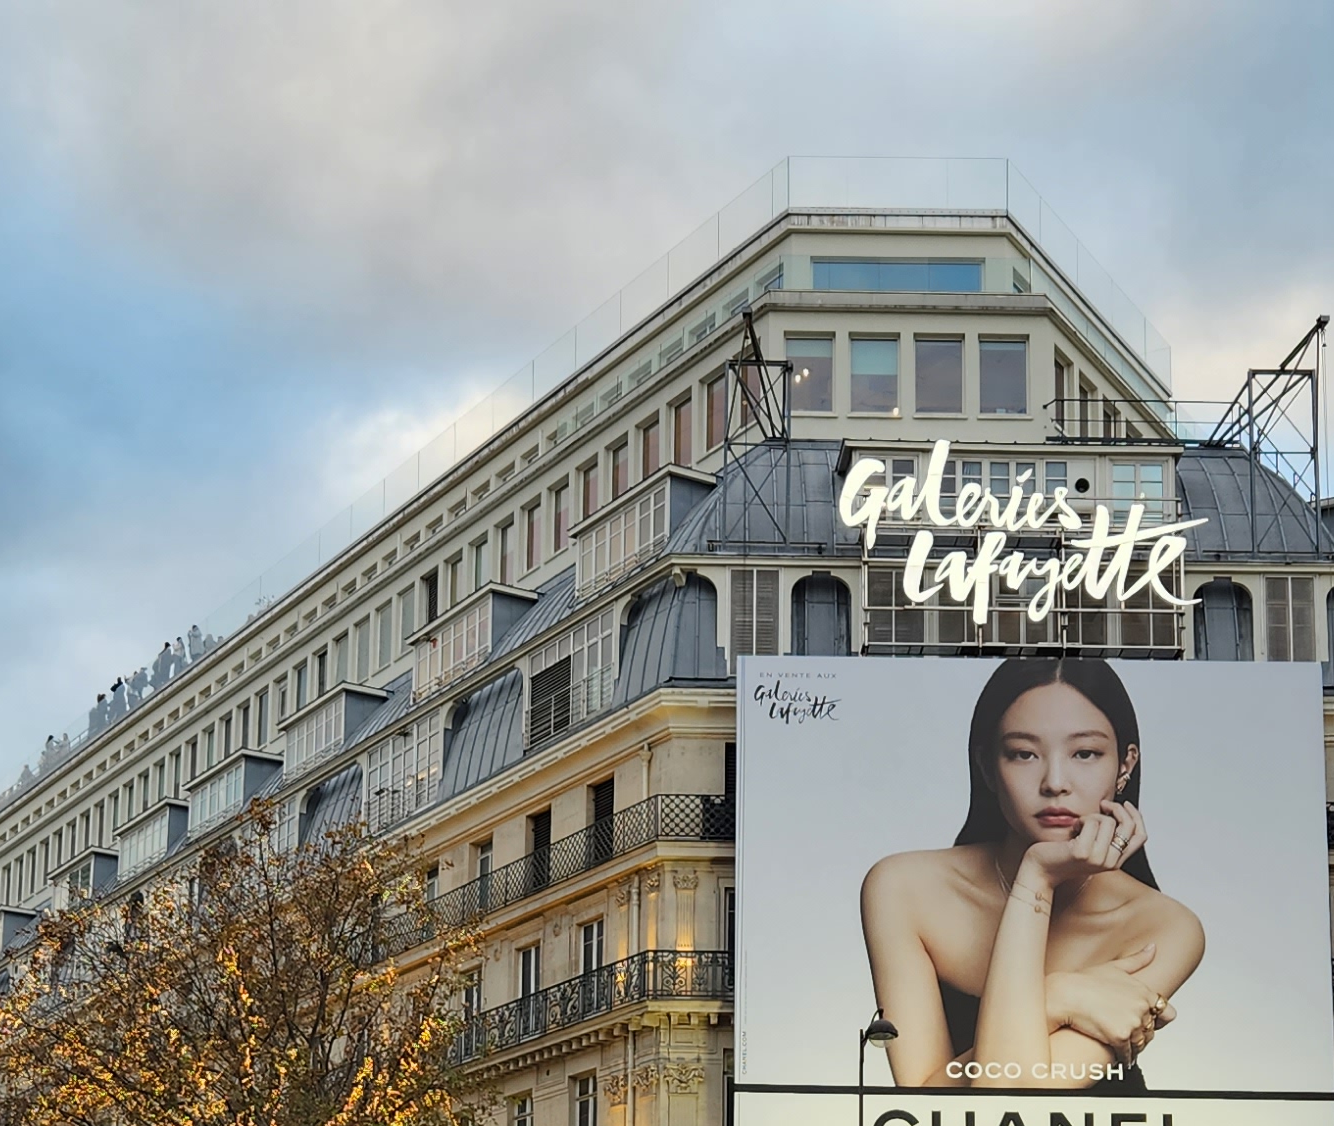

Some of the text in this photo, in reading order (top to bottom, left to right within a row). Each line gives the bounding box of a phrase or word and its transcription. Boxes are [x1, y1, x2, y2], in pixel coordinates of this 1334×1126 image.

[839, 439, 1083, 549] Galeries
[902, 504, 1209, 625] Lafayette
[754, 680, 811, 706] Galeries
[769, 695, 842, 725] Lafayette
[945, 1061, 1125, 1081] COCO CRUSH
